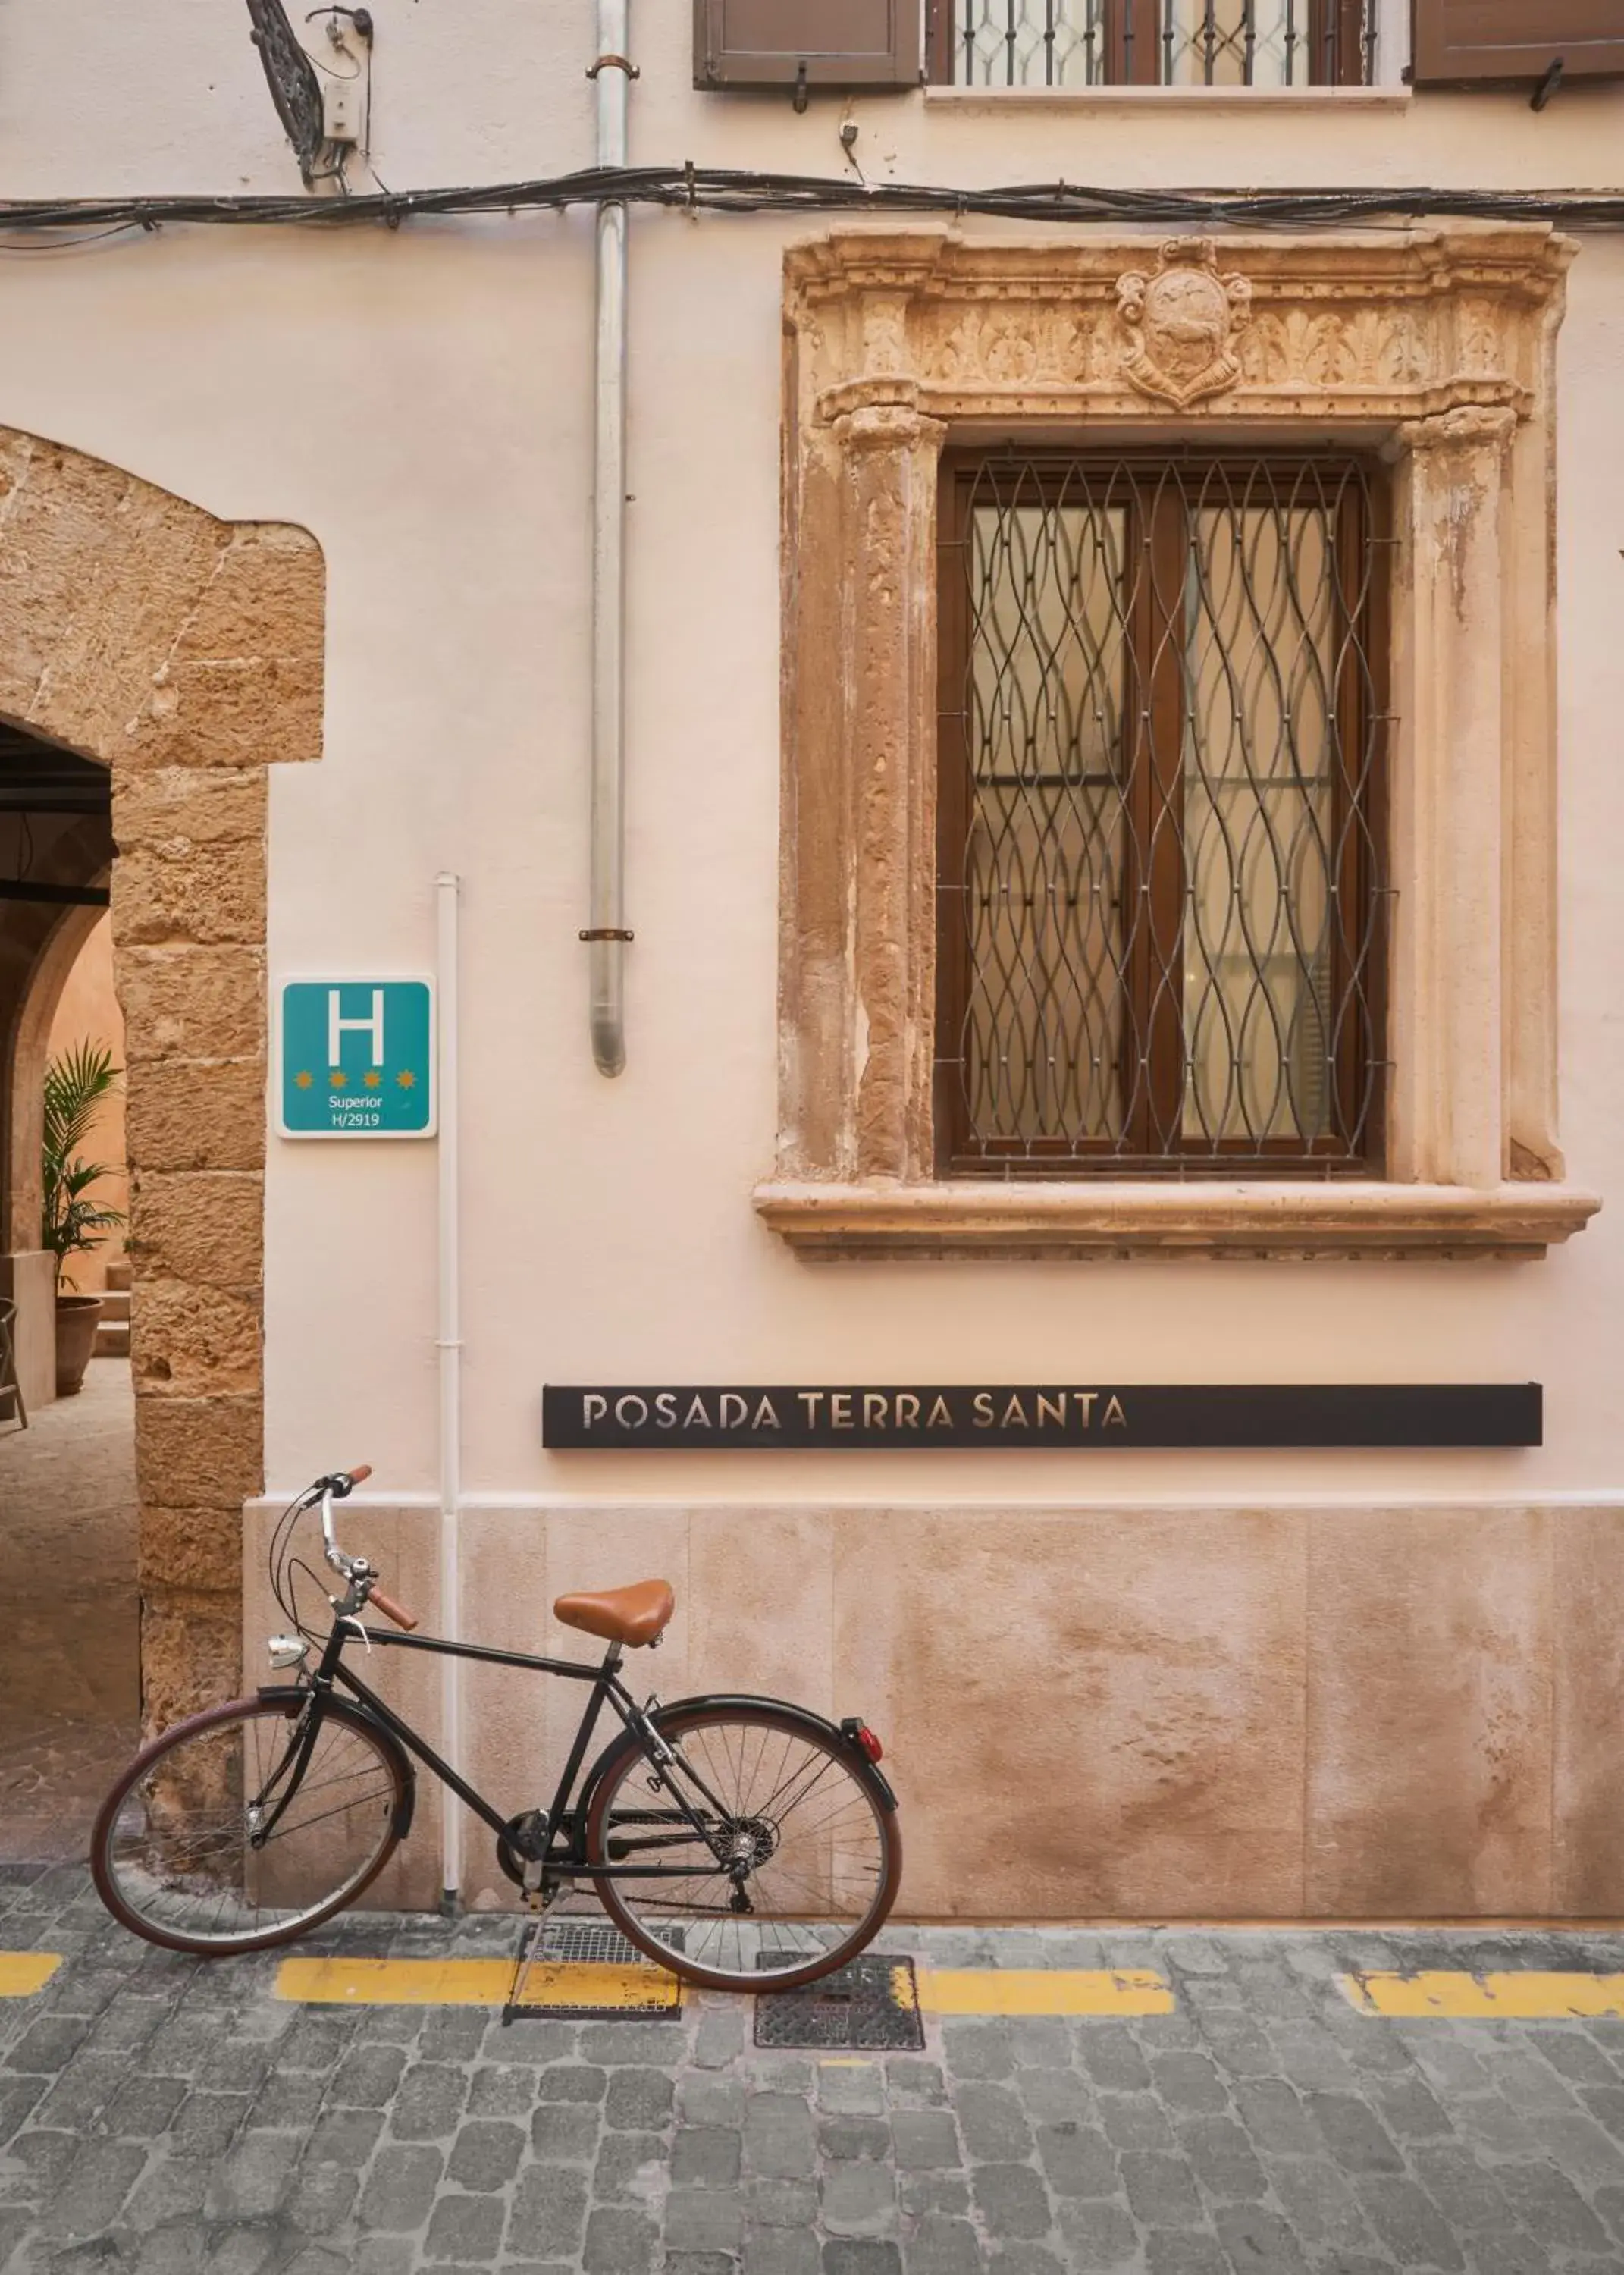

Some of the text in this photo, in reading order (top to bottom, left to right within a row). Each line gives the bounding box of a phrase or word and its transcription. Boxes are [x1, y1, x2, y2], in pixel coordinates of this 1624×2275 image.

[328, 990, 384, 1066] H
[328, 1096, 382, 1110] Superior
[332, 1113, 380, 1127] H/2919
[582, 1392, 1127, 1429] POSADA TERRA SANTA
